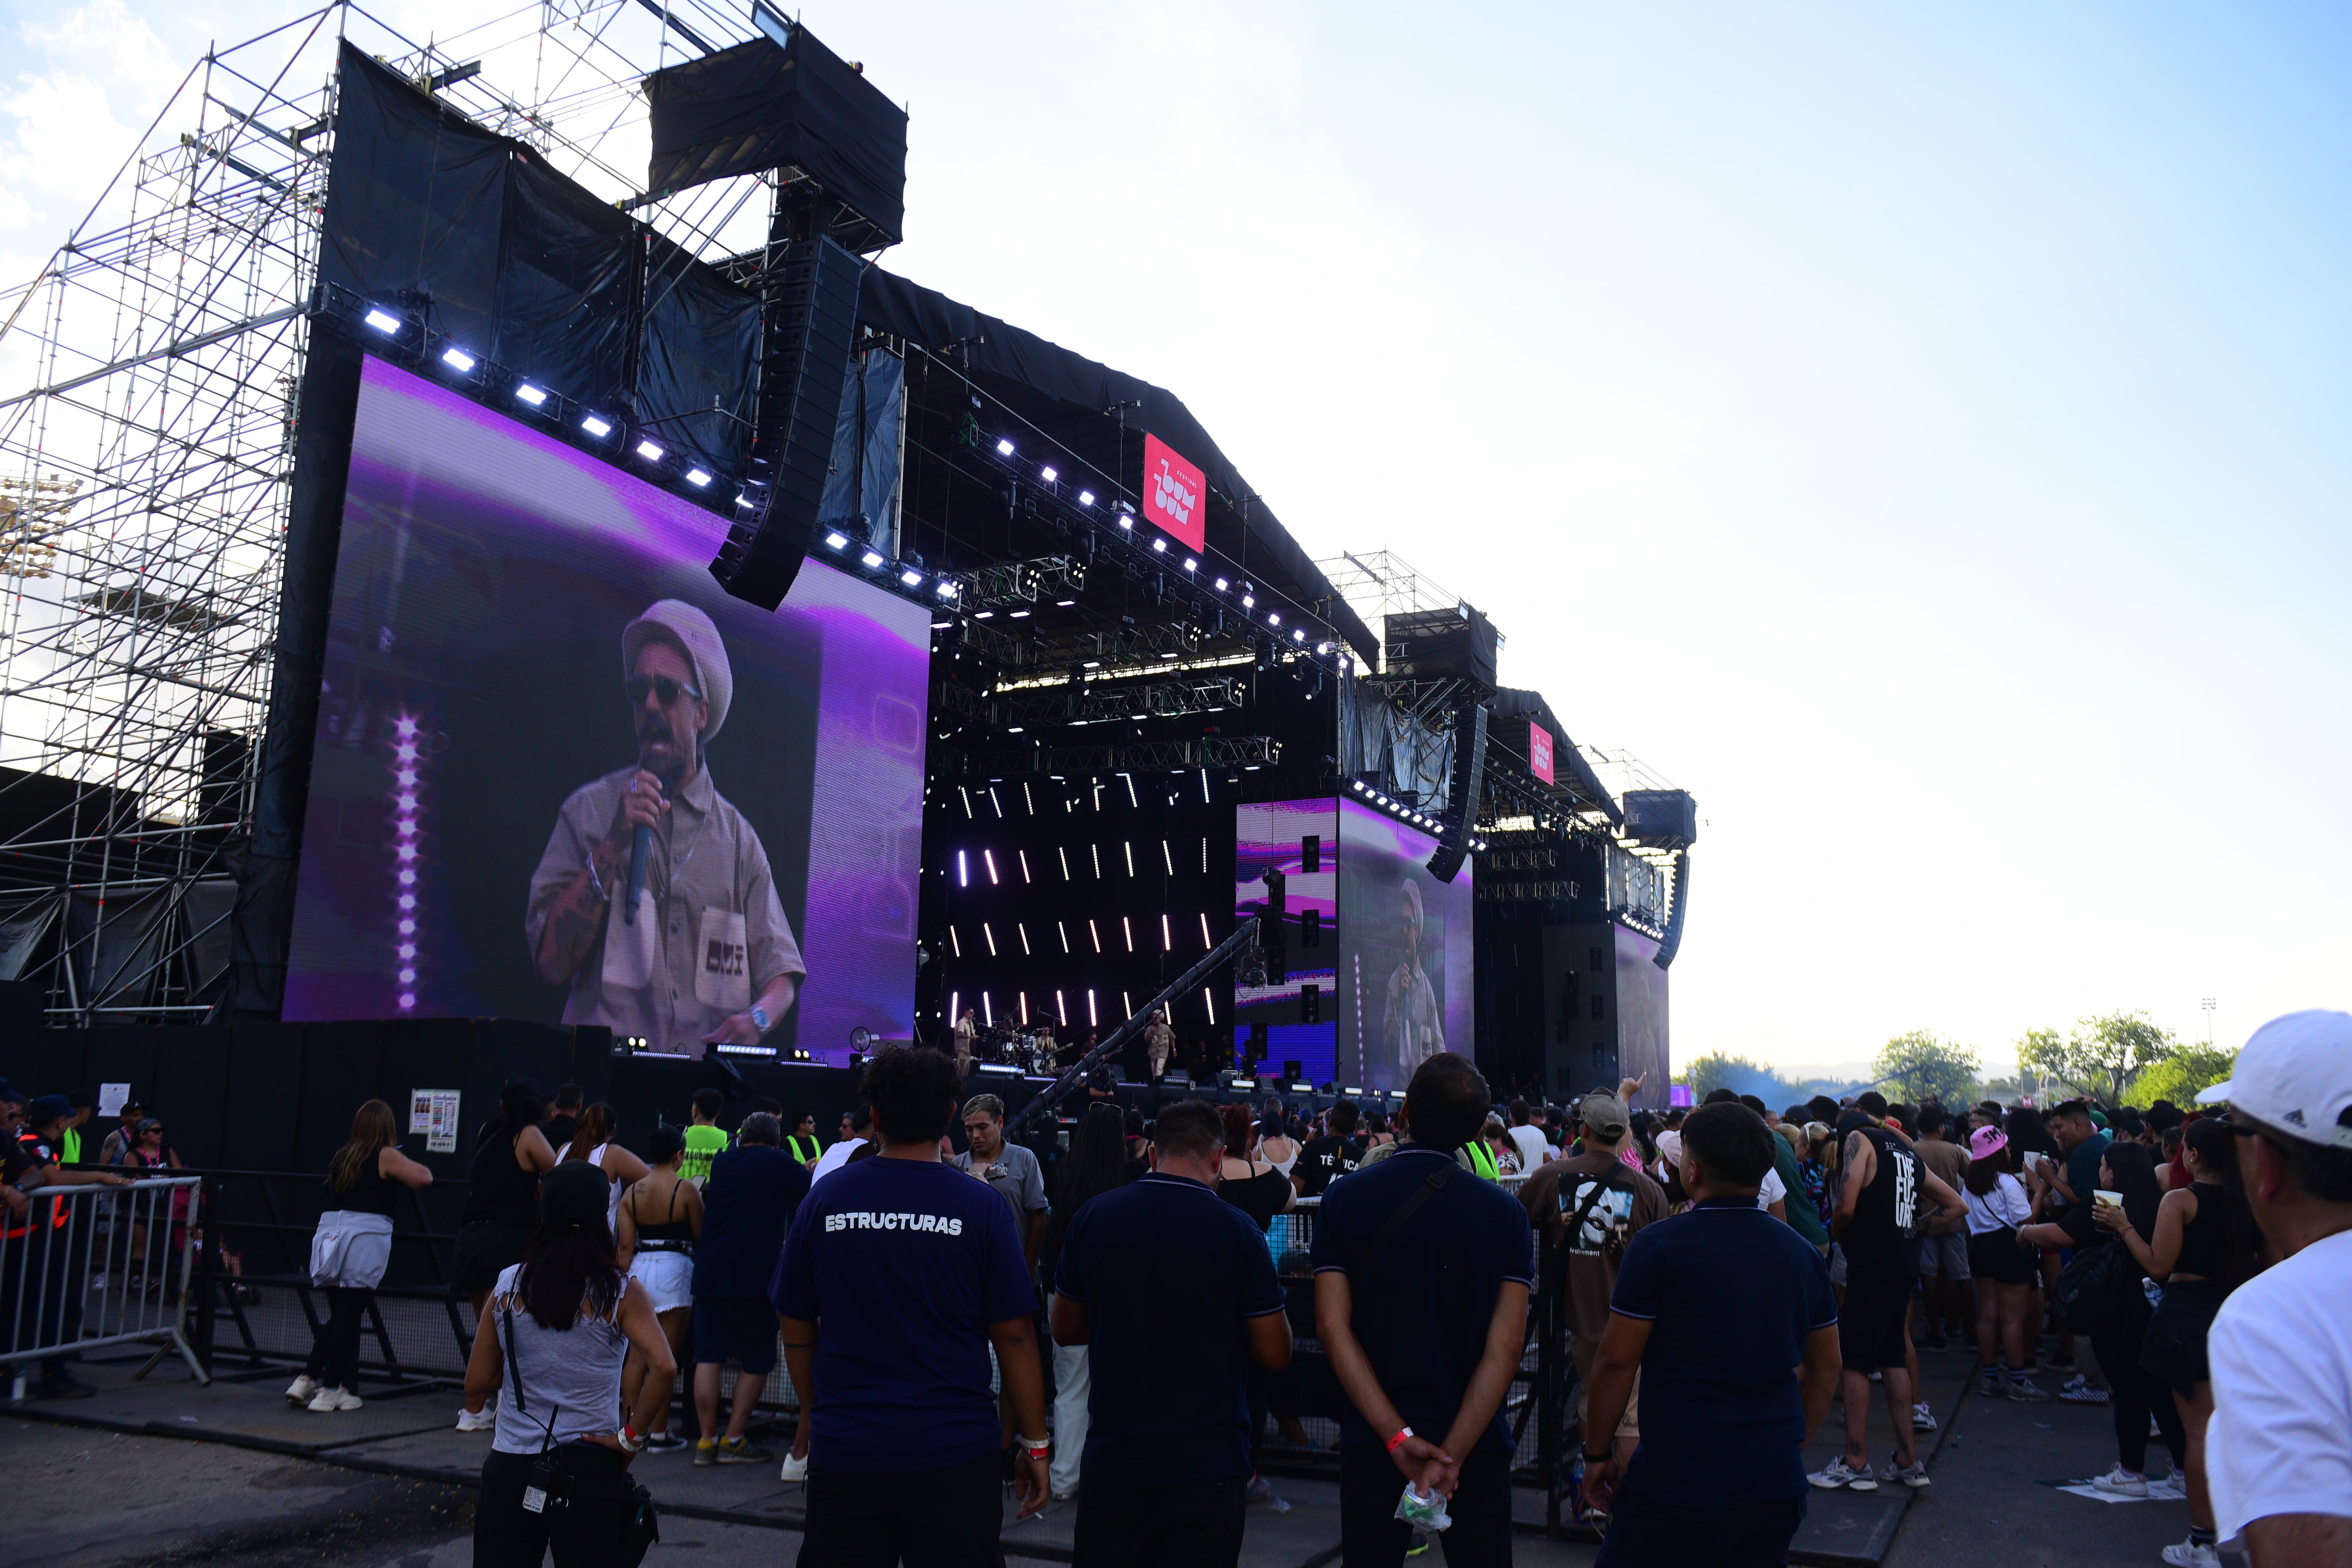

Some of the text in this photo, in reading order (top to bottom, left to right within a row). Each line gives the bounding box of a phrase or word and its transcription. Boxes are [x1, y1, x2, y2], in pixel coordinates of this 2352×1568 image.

[1176, 470, 1198, 488] FESTIVAL
[2023, 1097, 2032, 1106] M
[1320, 1154, 1359, 1171] TÉICA
[1893, 1152, 1914, 1178] THE
[825, 1212, 962, 1236] ESTRUCTURAS
